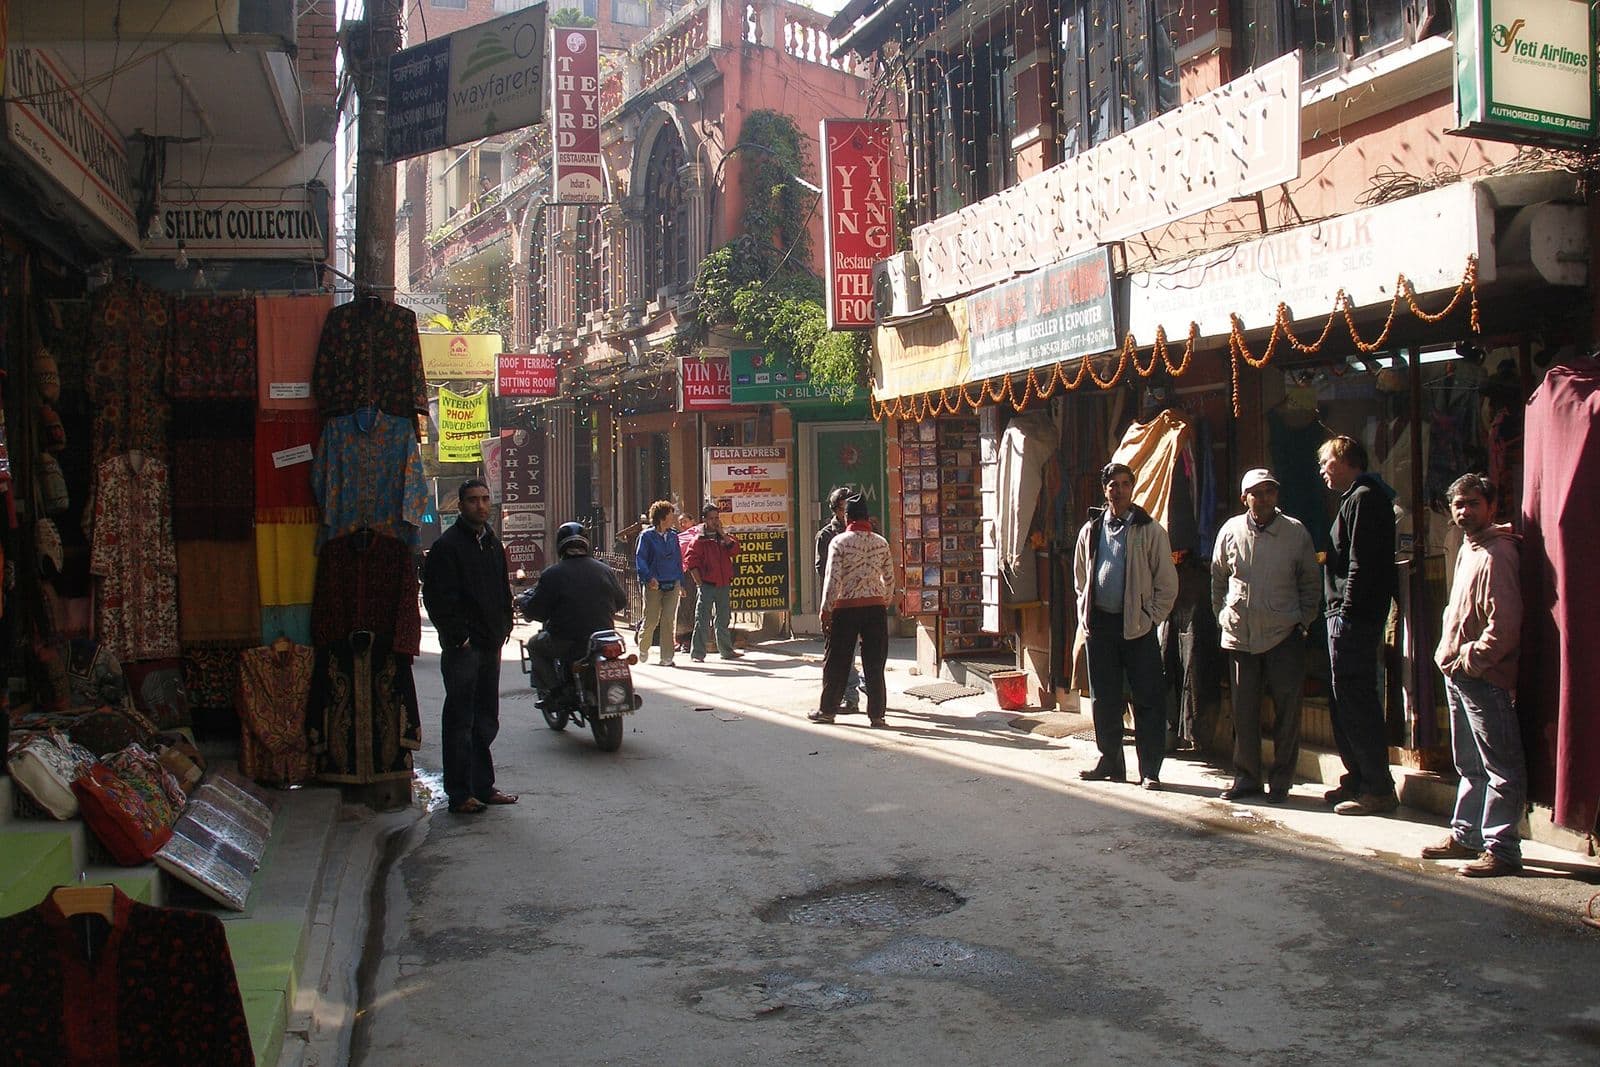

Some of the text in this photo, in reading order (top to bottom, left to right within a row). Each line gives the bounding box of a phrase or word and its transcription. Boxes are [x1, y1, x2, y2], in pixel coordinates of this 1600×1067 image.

[1514, 39, 1589, 67] Yeti Airlines
[453, 64, 540, 107] wayfarers
[557, 57, 577, 147] THIRD
[581, 77, 598, 129] EYE
[1491, 106, 1591, 131] AUTHORIZED SALES AGENT
[560, 153, 598, 164] RESTAURANT
[835, 166, 860, 235] YIN
[863, 156, 889, 249] YANG
[164, 209, 223, 240] SELECT
[1310, 213, 1374, 257] SILK
[1341, 254, 1374, 271] SILKS
[1066, 304, 1102, 331] EXPORTER
[500, 357, 557, 369] ROOF TERRACE
[500, 376, 556, 387] SITTING ROOM
[684, 363, 711, 382] YIN
[686, 384, 715, 396] THAI
[713, 448, 780, 458] DELTA EXPRESS
[505, 447, 520, 502] THIRD
[528, 455, 541, 496] EYE
[727, 465, 769, 476] FedEx
[503, 503, 545, 511] RESTAURANT
[731, 512, 781, 524] CARGO
[748, 532, 769, 540] CYBER
[769, 531, 785, 539] CAFE
[740, 564, 764, 574] FAX
[757, 574, 785, 585] COPY
[745, 600, 758, 608] CD
[760, 598, 785, 607] BURN
